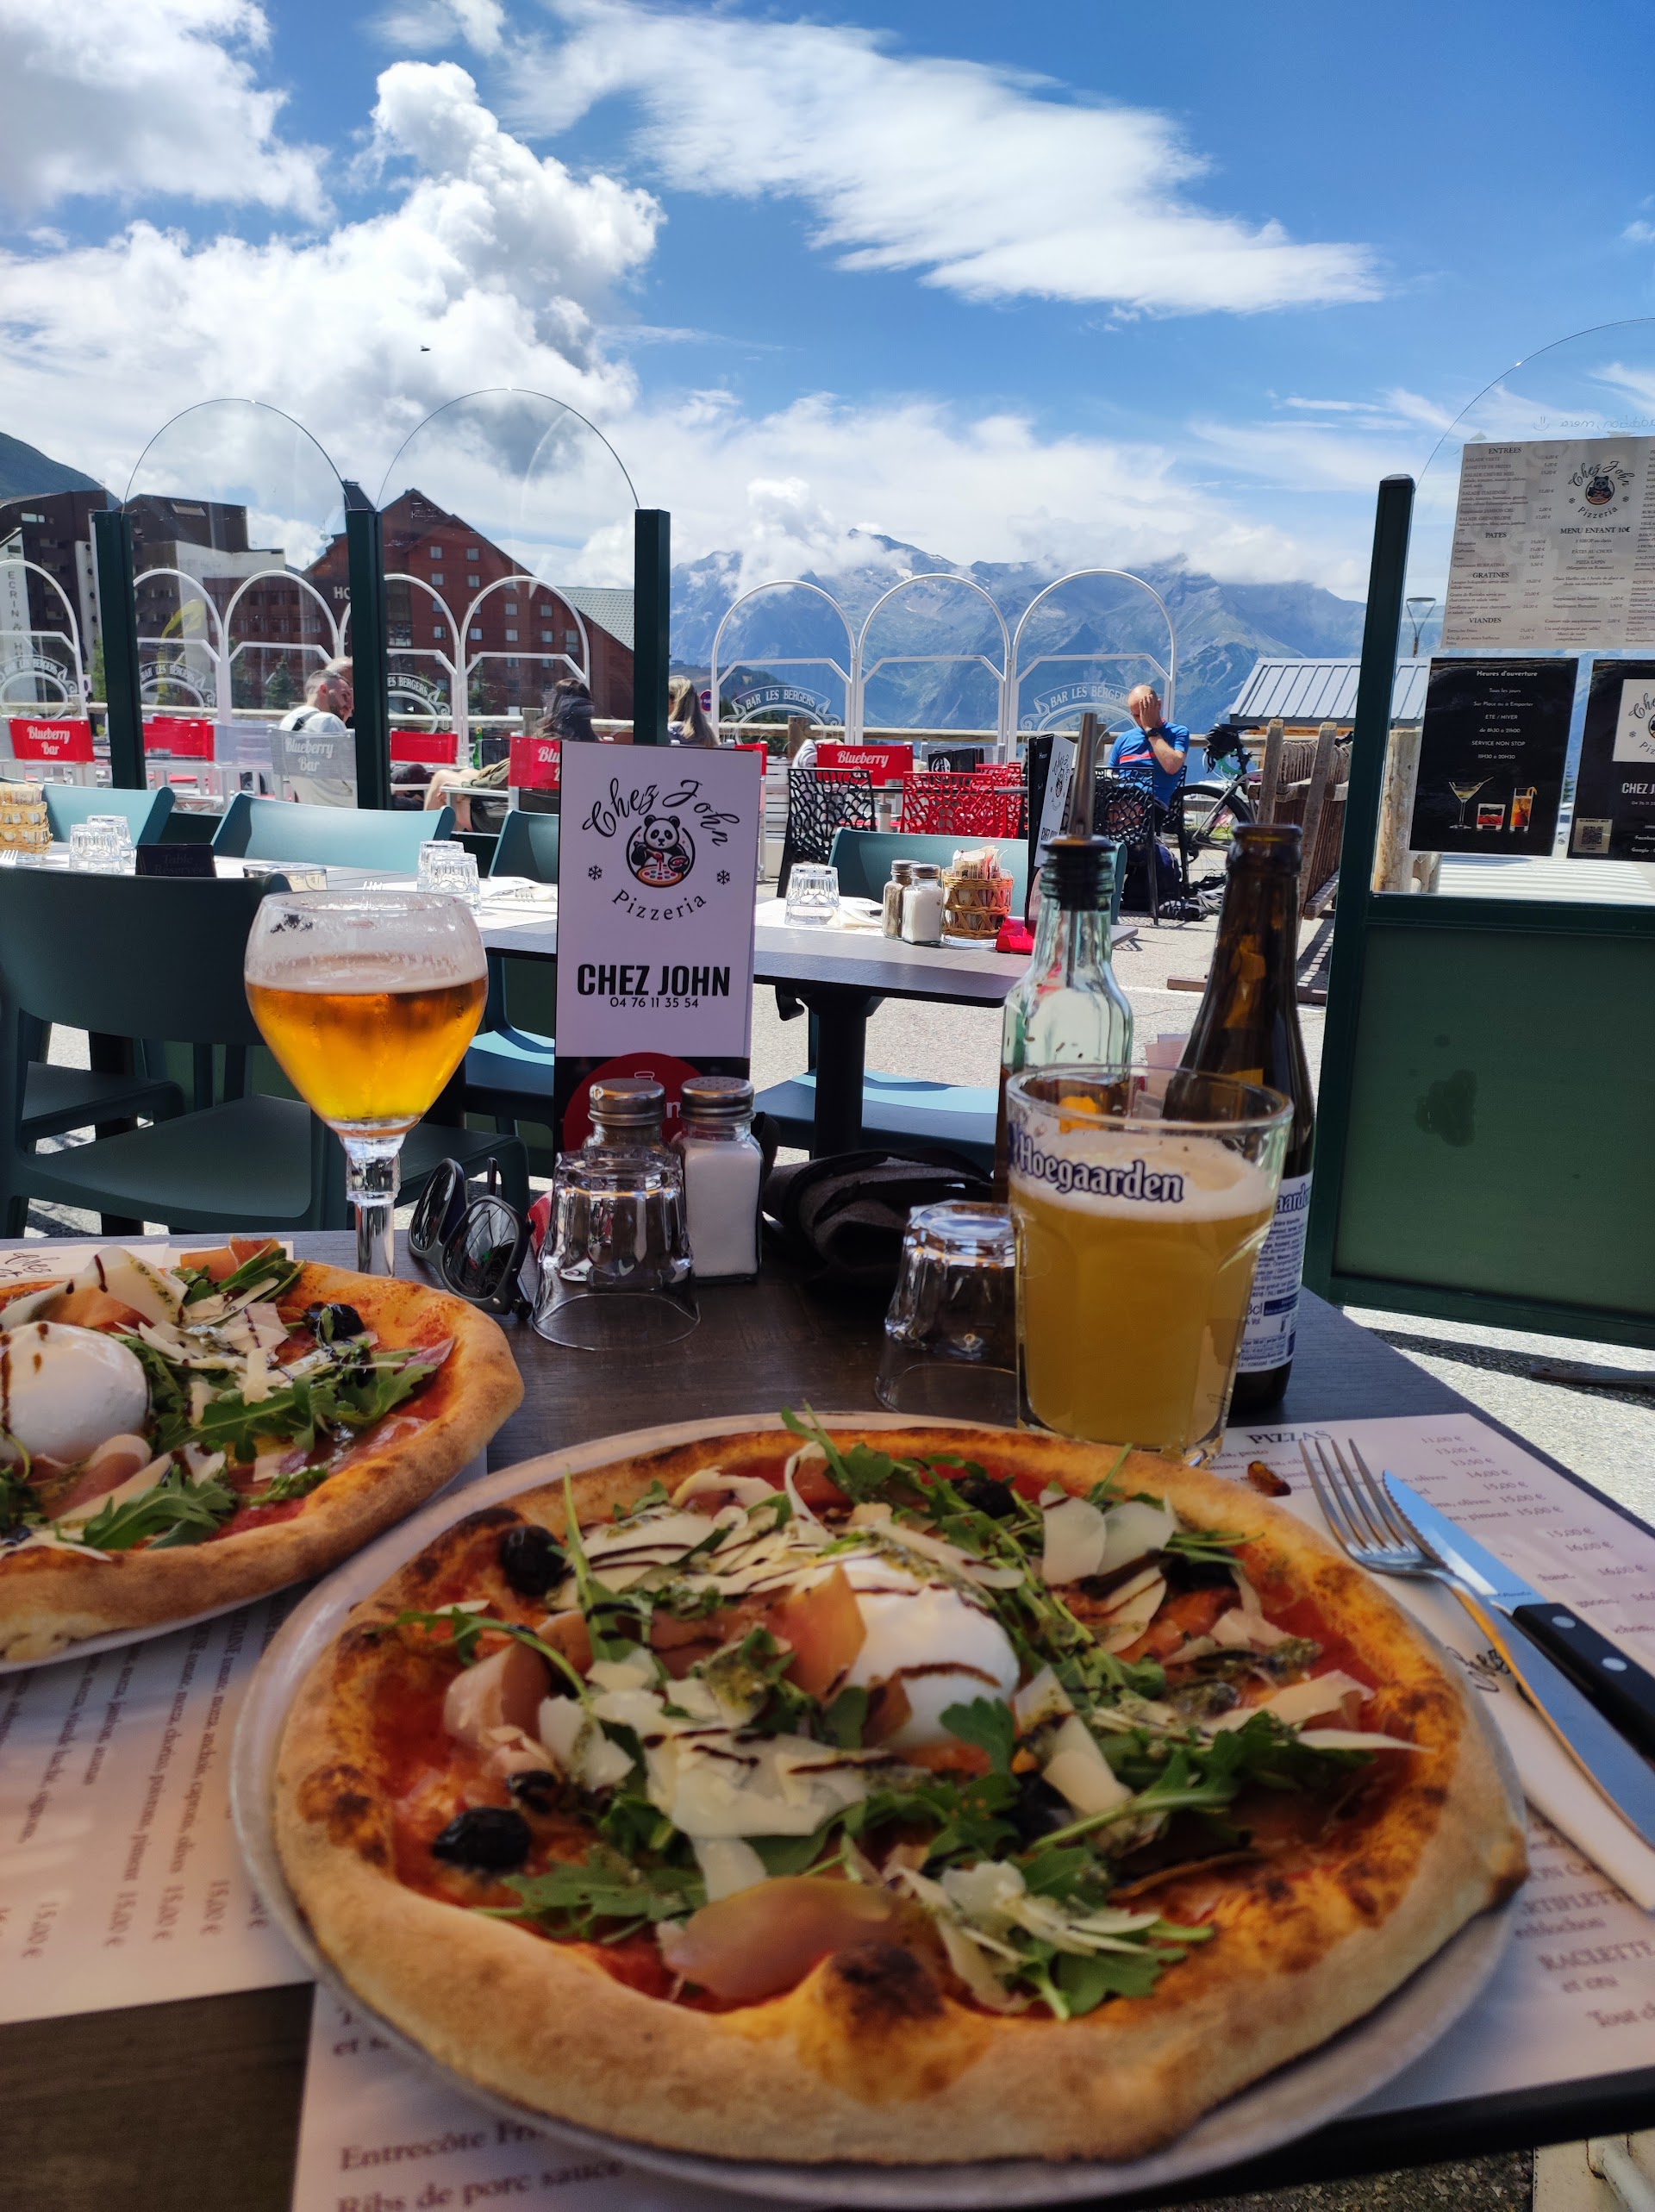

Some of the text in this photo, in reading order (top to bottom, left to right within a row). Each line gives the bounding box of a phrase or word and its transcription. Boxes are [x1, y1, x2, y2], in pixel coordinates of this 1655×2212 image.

[1567, 462, 1602, 487] Chez
[1602, 460, 1636, 487] John
[1577, 507, 1619, 519] Pizzeria
[387, 676, 428, 697] ES BERGERS
[1050, 691, 1069, 707] BAR
[1071, 687, 1088, 699] LES
[746, 690, 816, 709] BAR LES BERGERS
[27, 724, 71, 744] Blueberry
[41, 741, 61, 756] Bar
[284, 736, 334, 759] Blueberry
[837, 750, 890, 768] Blueberry
[298, 756, 321, 773] Bar
[1621, 783, 1649, 794] CHEZ
[582, 778, 740, 847] Chez John
[612, 889, 707, 922] Pizzeria
[577, 964, 731, 997] CHEZ JOHN
[609, 997, 699, 1009] 04 76 11 35 54
[1019, 1132, 1184, 1203] Hoegaarden
[1246, 1429, 1333, 1445] PIZZAS
[214, 1657, 234, 1693] tomate,
[193, 1733, 217, 1778] anchois,
[124, 1834, 153, 1883] piment
[169, 1836, 197, 1874] olives
[109, 1890, 140, 1933] 15,00
[157, 1884, 186, 1927] 15,00
[203, 1879, 231, 1921] 15,00
[22, 1902, 60, 1959] 15,00 €
[152, 1929, 175, 1941] €
[200, 1923, 222, 1935] €
[103, 1937, 126, 1948] €
[339, 2131, 487, 2171] Entrecôte
[415, 2182, 453, 2209] de
[462, 2172, 532, 2208] porc
[540, 2158, 626, 2190] sauce
